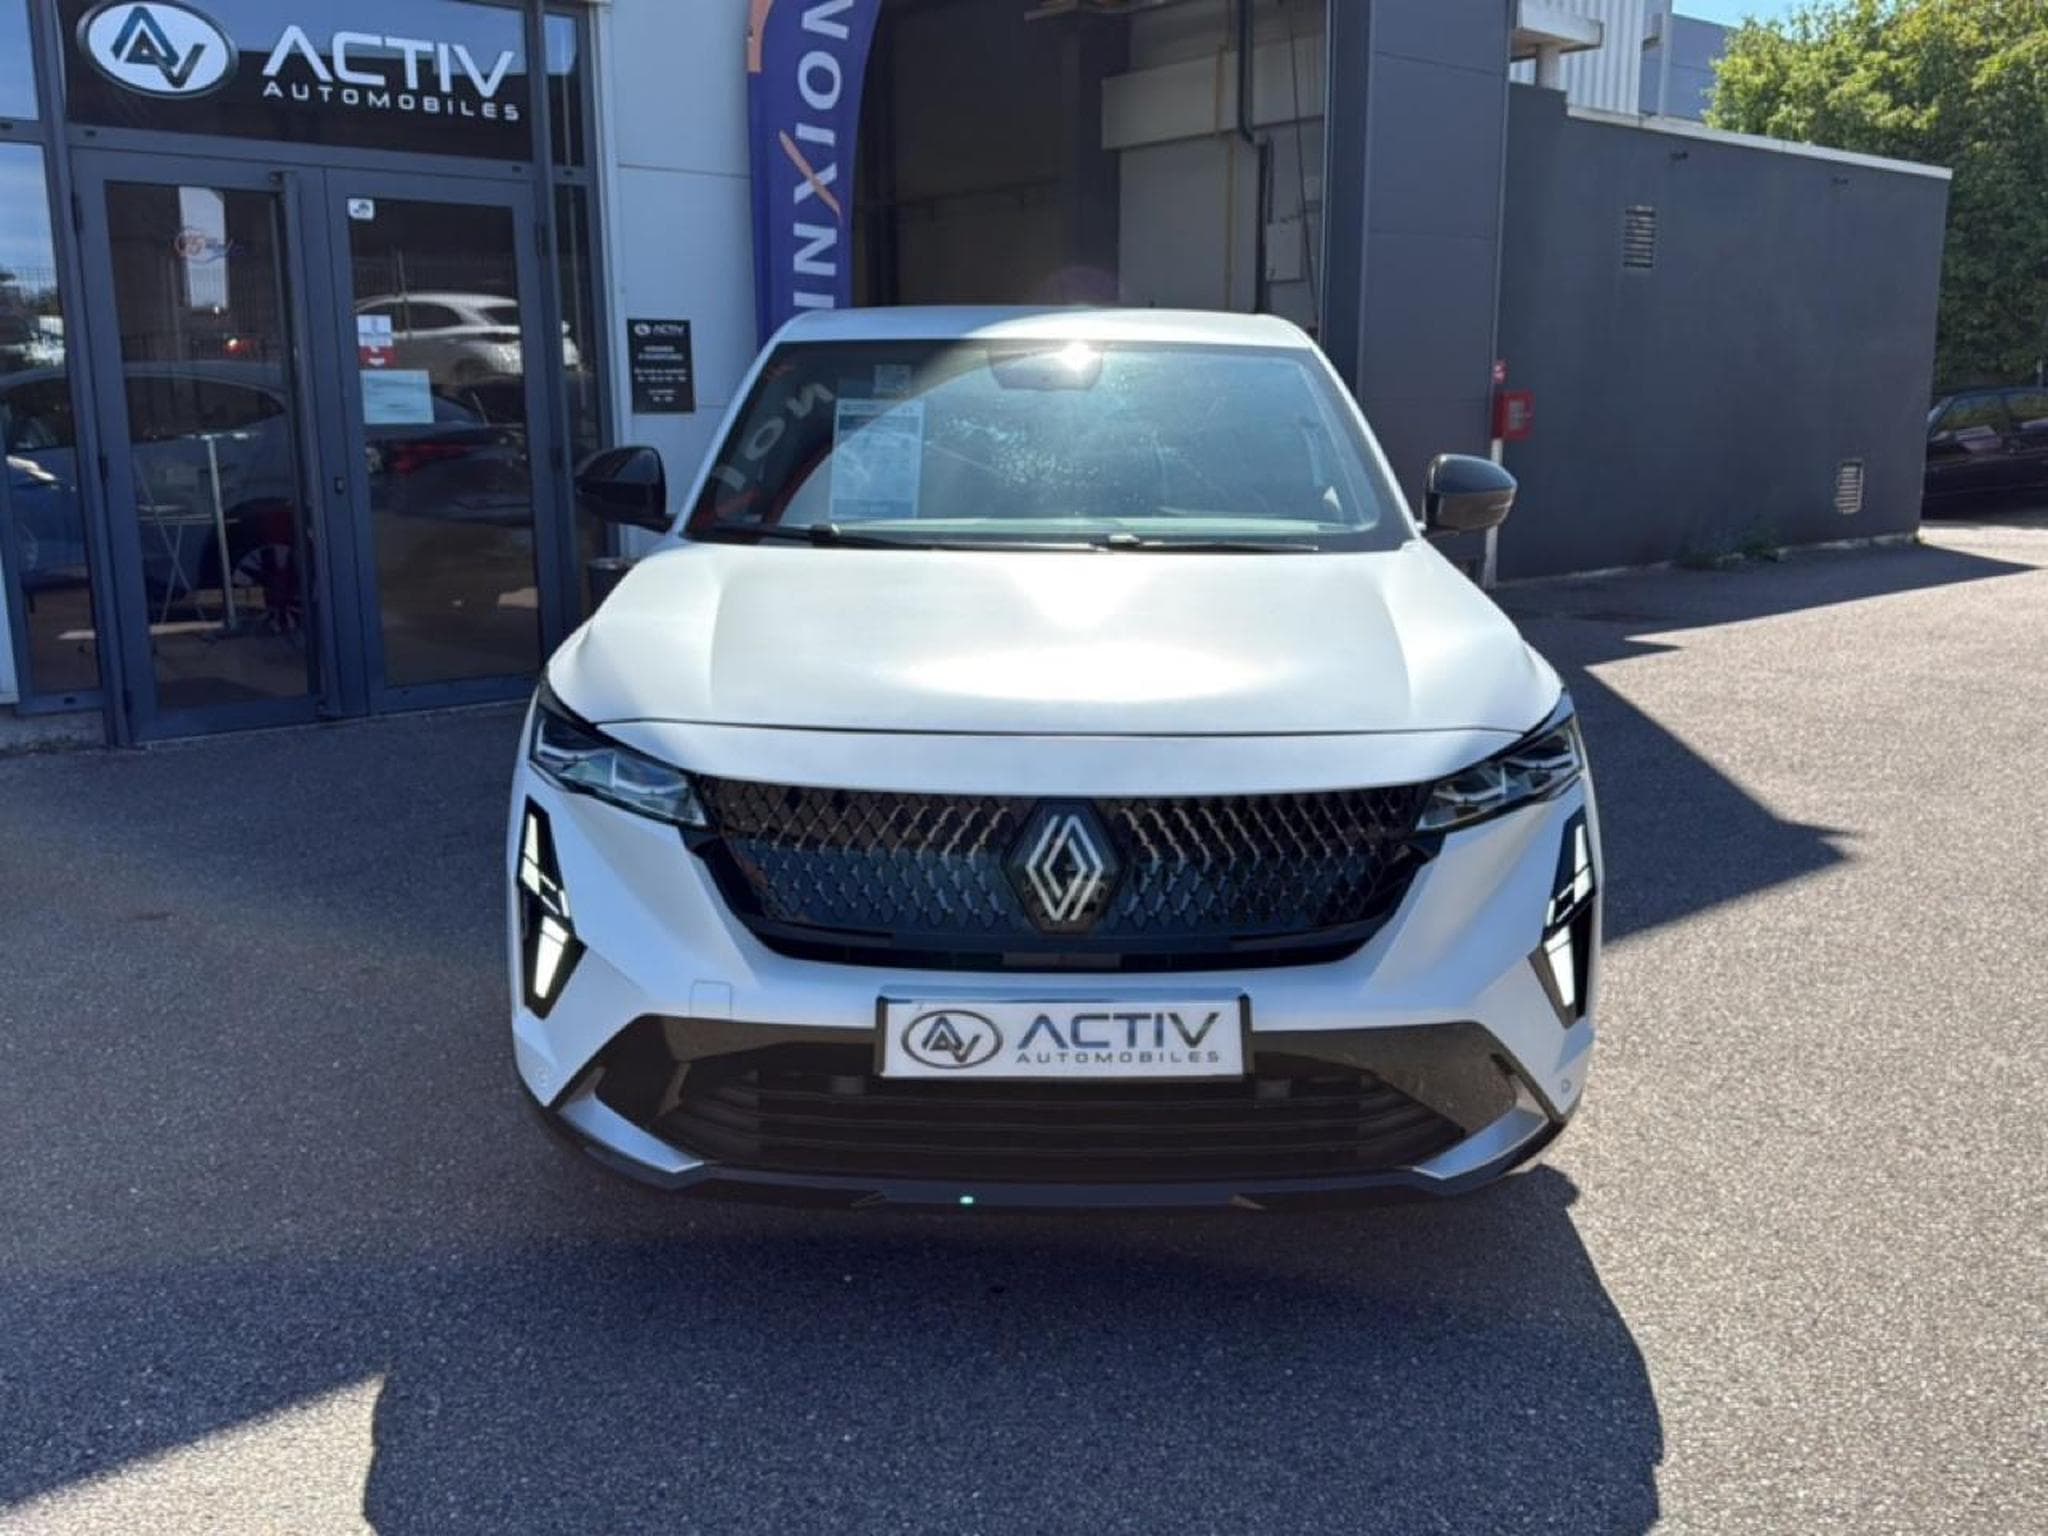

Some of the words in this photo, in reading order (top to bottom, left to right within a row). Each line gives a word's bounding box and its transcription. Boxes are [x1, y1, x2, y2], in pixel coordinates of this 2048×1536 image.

[262, 25, 515, 98] ACTIV
[263, 80, 520, 121] AUTOMOBILES
[1016, 1012, 1221, 1050] ACTIV
[1015, 1051, 1220, 1064] AUTOMOBILES
